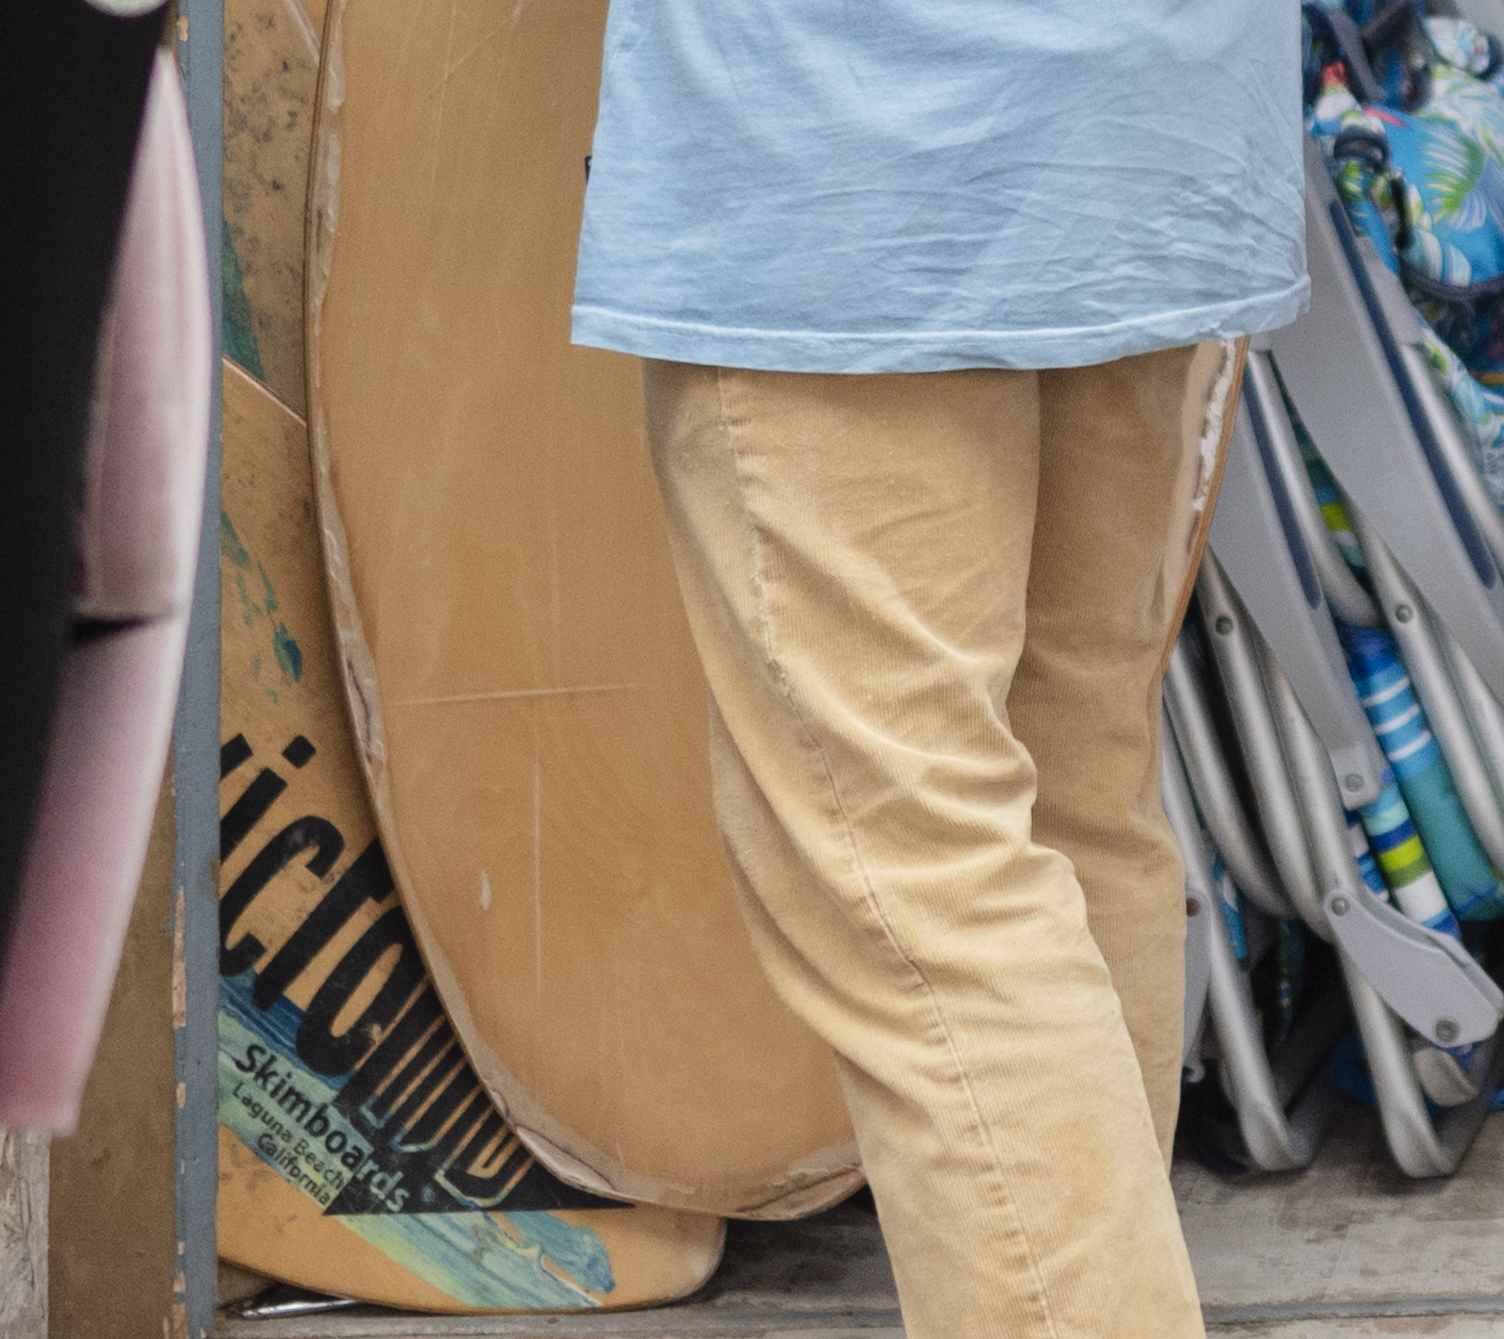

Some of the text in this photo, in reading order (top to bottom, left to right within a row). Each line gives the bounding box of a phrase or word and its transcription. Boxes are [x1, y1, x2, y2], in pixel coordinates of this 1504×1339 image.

[232, 1081, 345, 1192] Laguna Beach
[234, 1043, 410, 1213] Skimboards
[256, 1132, 332, 1207] California
